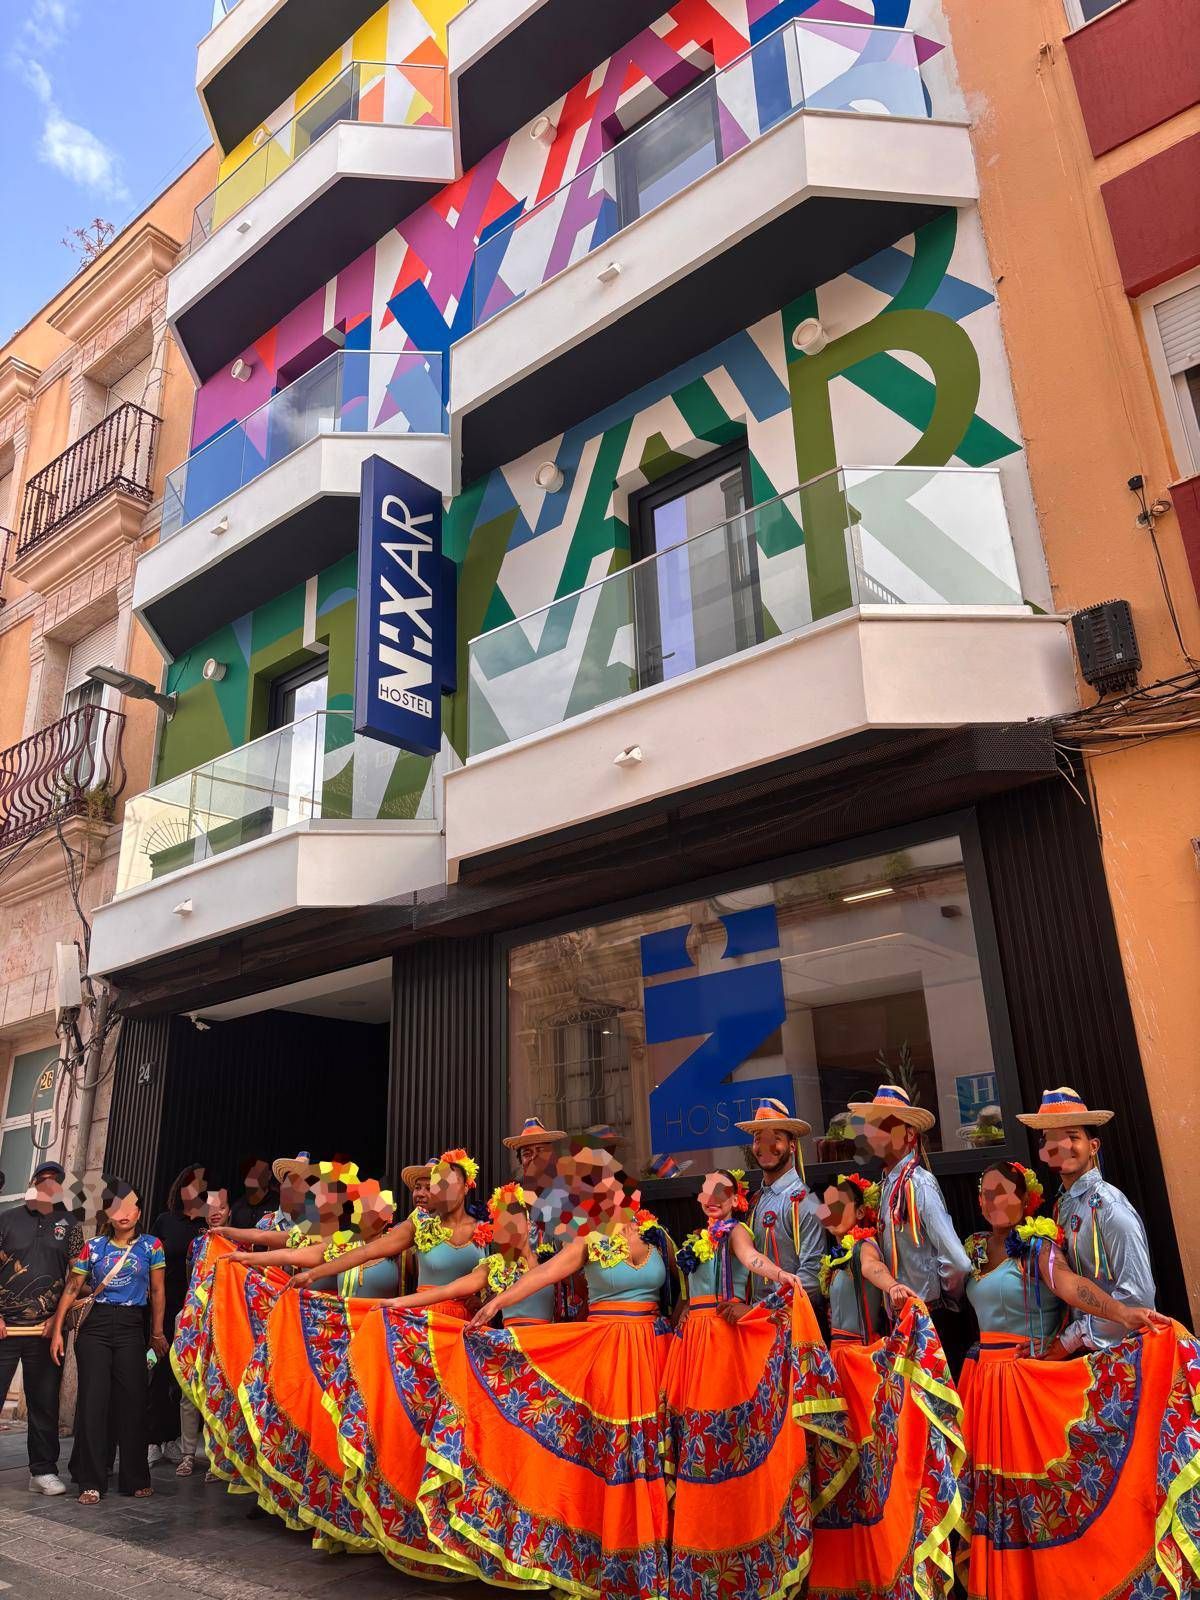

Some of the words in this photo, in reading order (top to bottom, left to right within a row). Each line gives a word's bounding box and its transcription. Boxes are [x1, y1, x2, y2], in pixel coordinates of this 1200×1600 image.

[380, 686, 430, 715] HOSTEL
[41, 1071, 53, 1089] 26
[138, 1063, 150, 1084] 24
